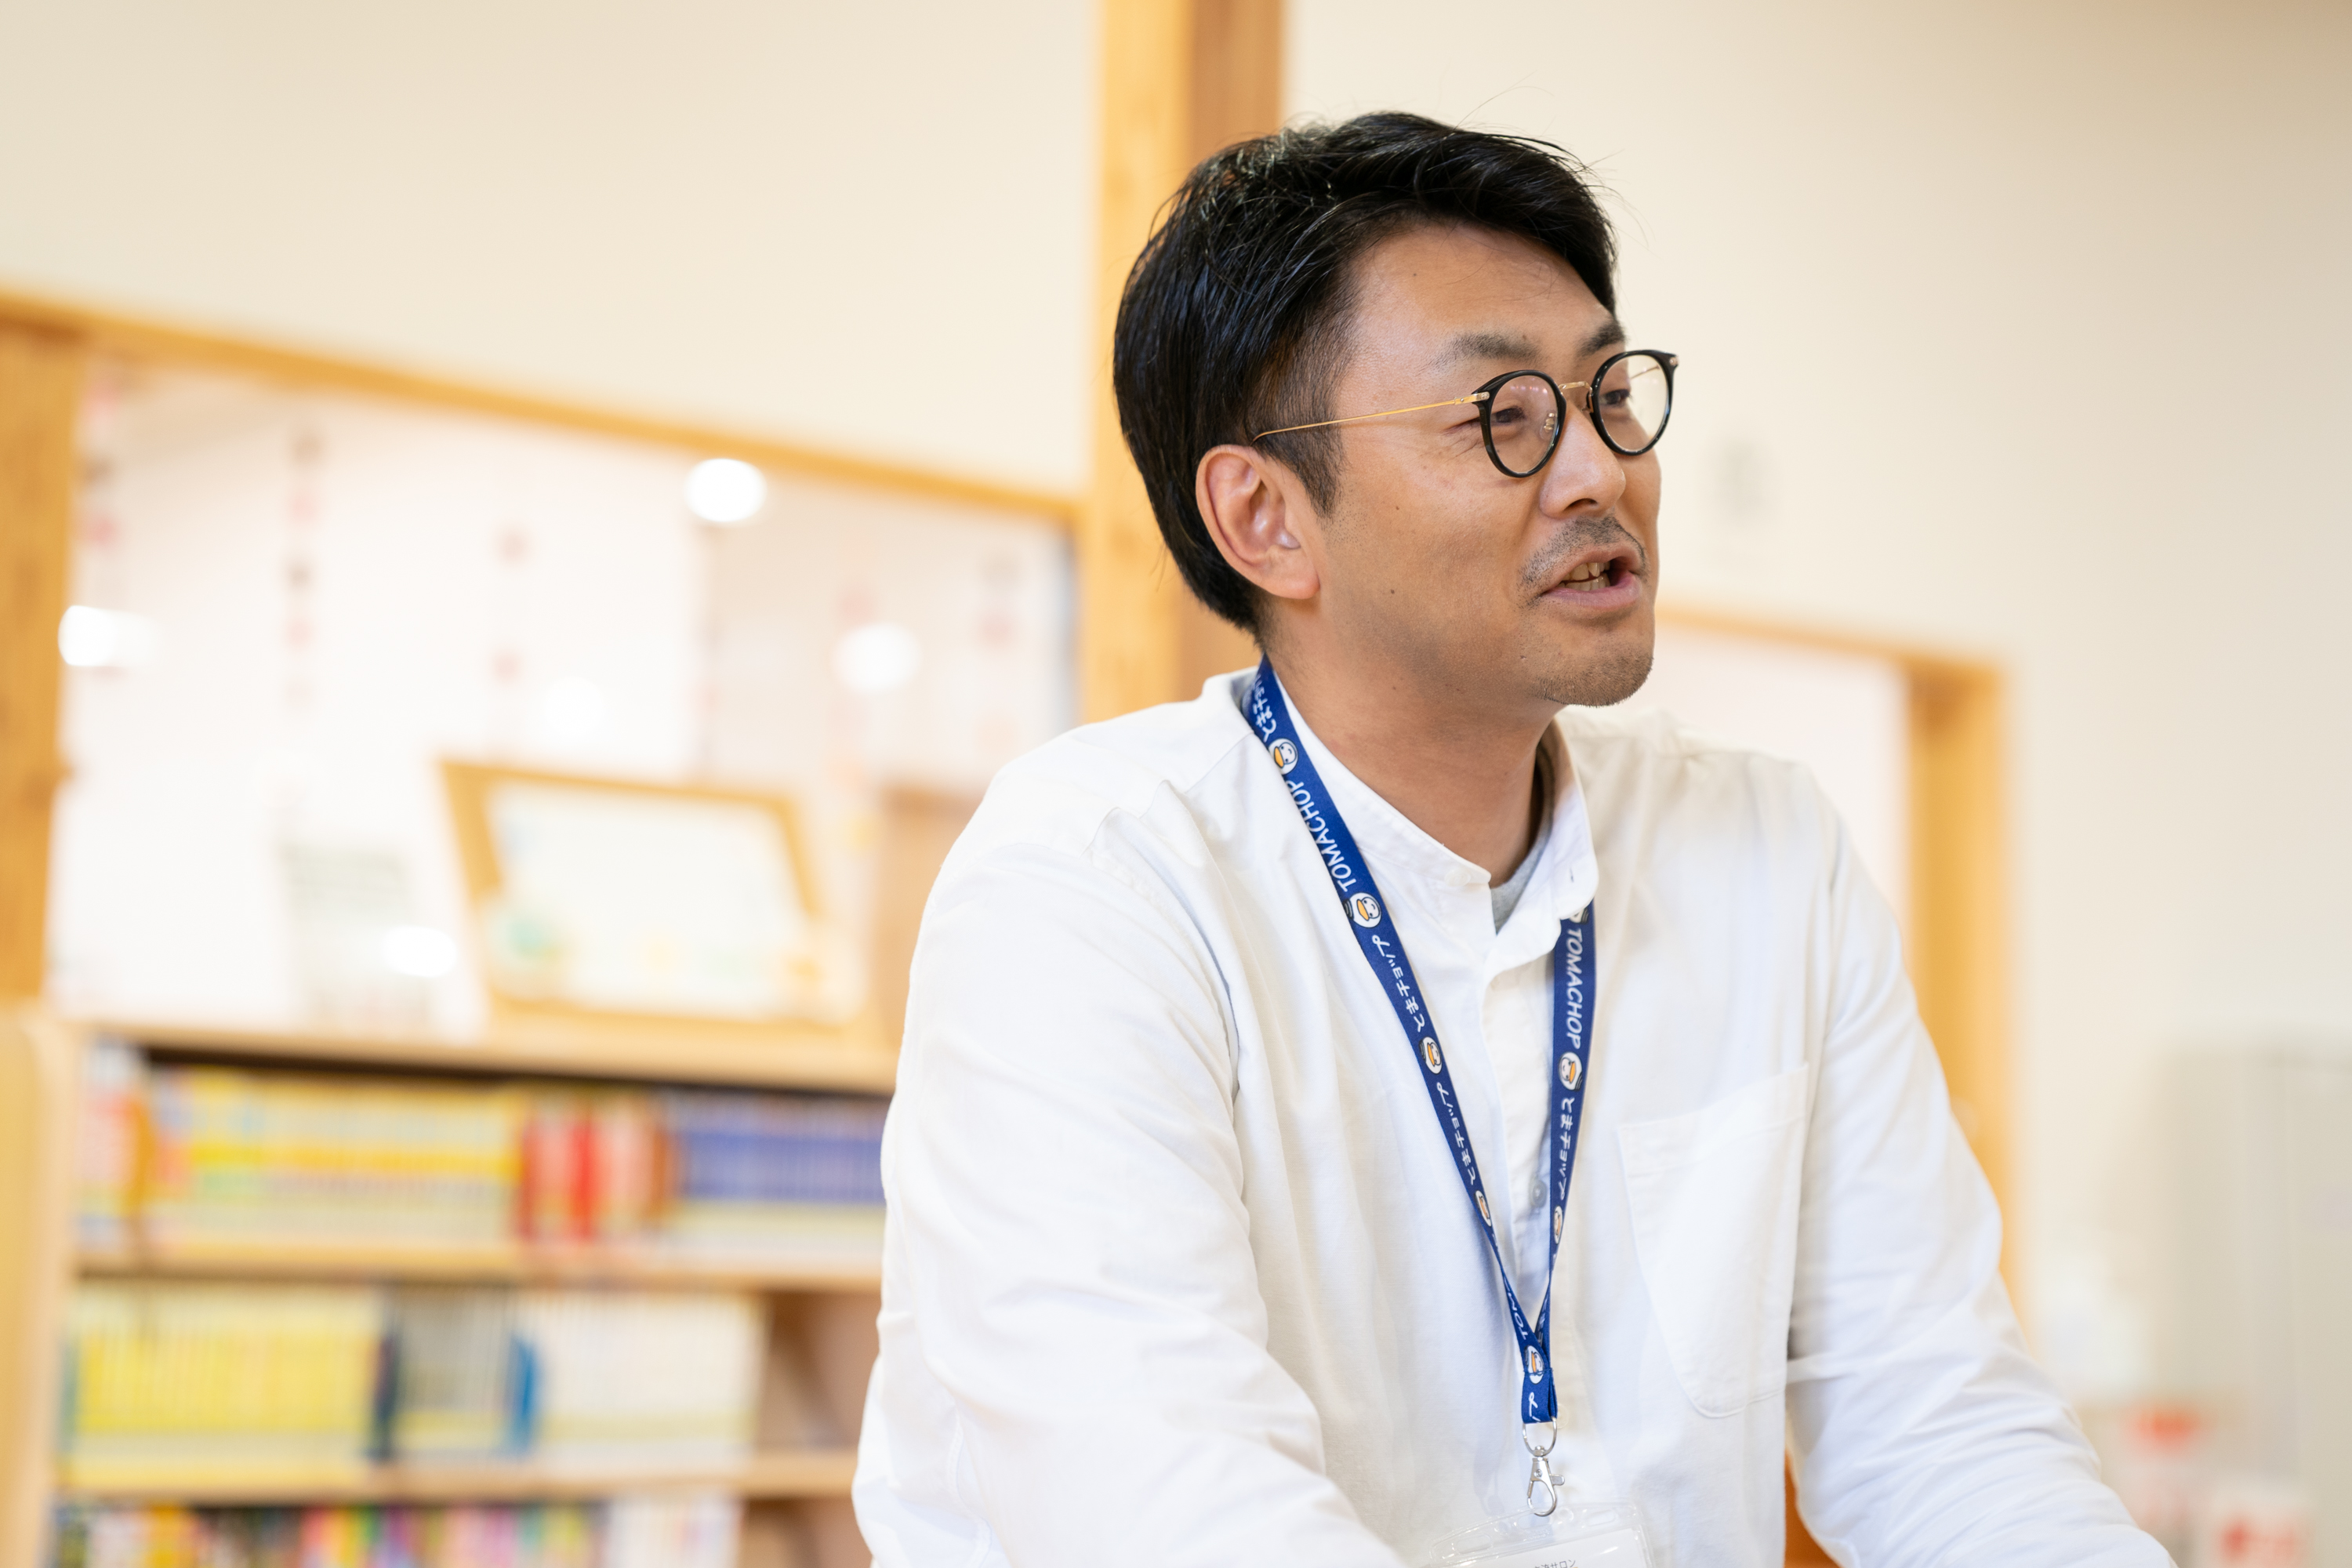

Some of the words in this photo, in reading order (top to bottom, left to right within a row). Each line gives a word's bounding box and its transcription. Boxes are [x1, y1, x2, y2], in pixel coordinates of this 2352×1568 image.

[1285, 779, 1357, 892] TOMACHOP
[1372, 935, 1426, 1033] とまチョップ
[1566, 928, 1584, 1050] TOMACHOP
[1437, 1082, 1475, 1185] とまチョップ
[1558, 1097, 1575, 1200] とまチョップ
